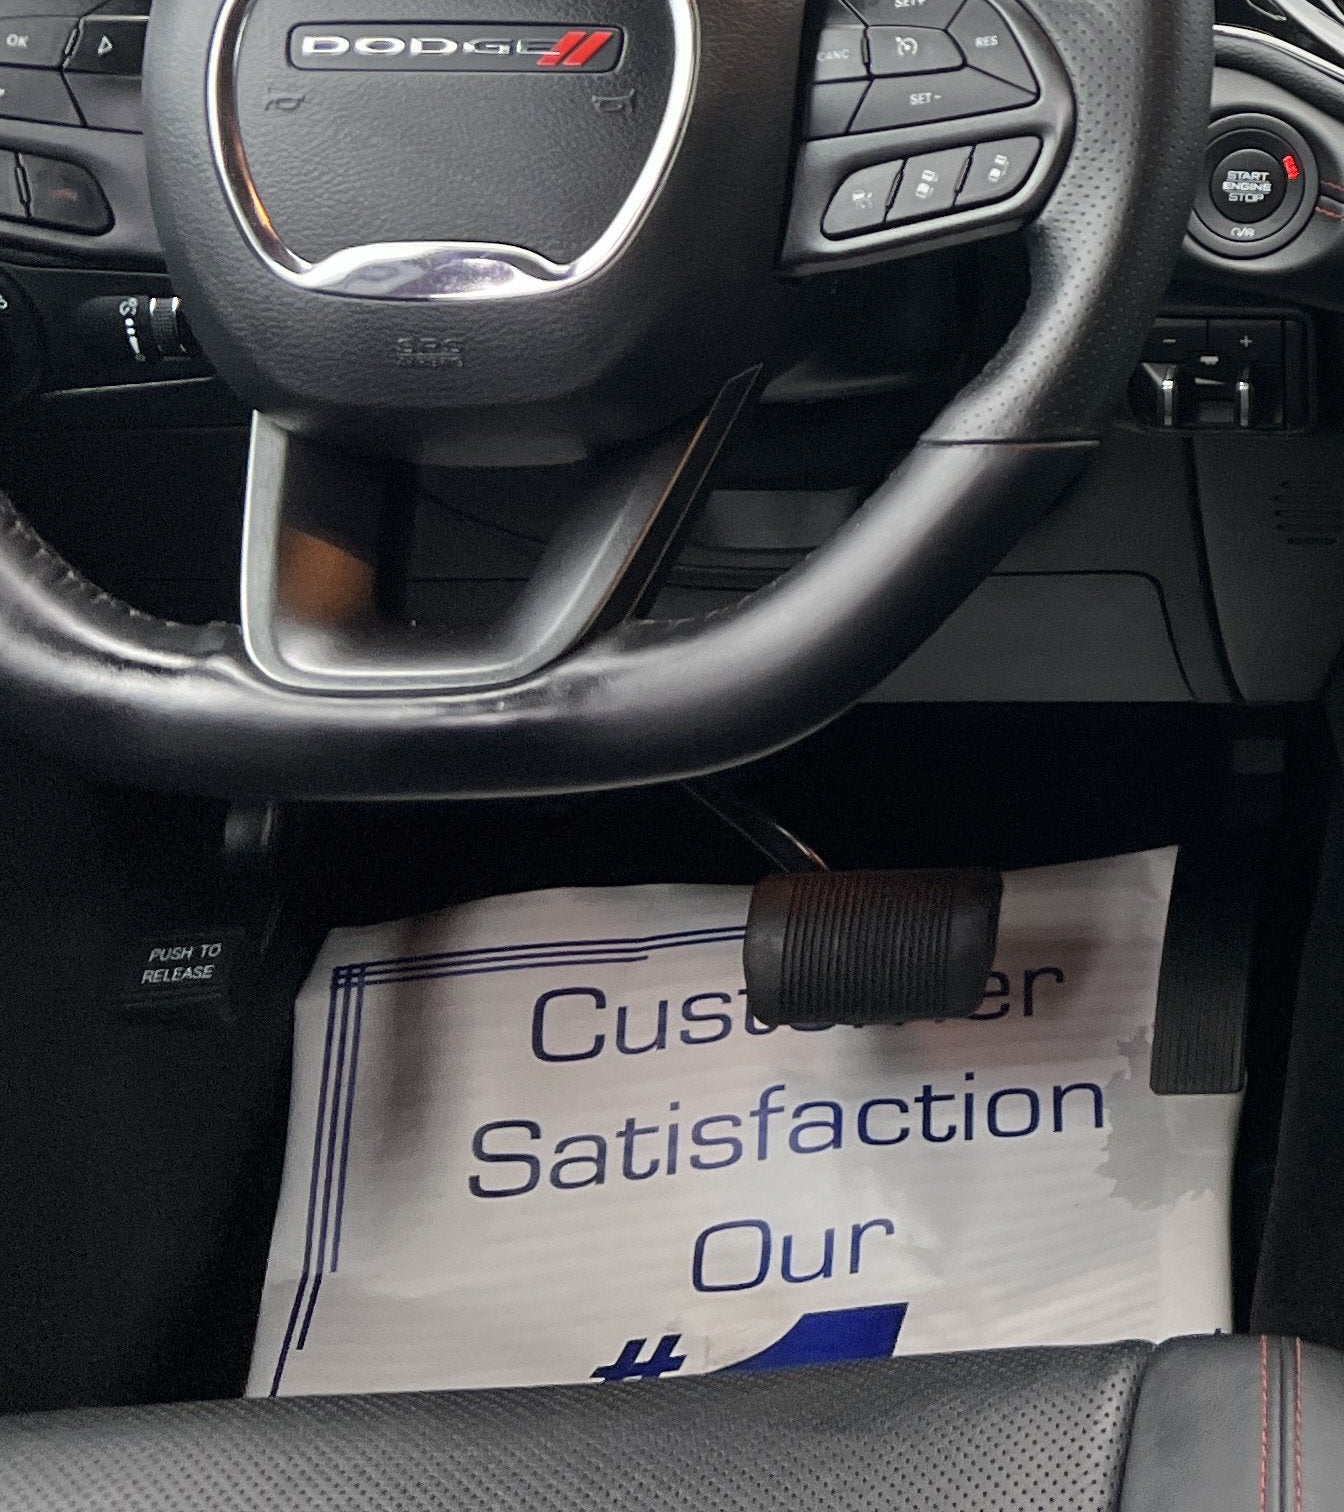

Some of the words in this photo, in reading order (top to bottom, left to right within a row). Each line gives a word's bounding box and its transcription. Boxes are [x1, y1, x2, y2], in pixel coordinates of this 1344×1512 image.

[6, 33, 29, 48] OK
[301, 35, 562, 58] DODGE
[975, 35, 999, 47] RES
[816, 48, 850, 62] CANC
[1227, 170, 1270, 181] START
[1222, 181, 1272, 192] ENGINE
[1228, 192, 1264, 203] STOP
[148, 946, 194, 963] PUSH
[200, 942, 222, 958] TO
[141, 964, 215, 985] RELEASE
[531, 965, 1065, 1063] Custer
[468, 1071, 1105, 1201] Satisfaction
[692, 1217, 895, 1293] Our
